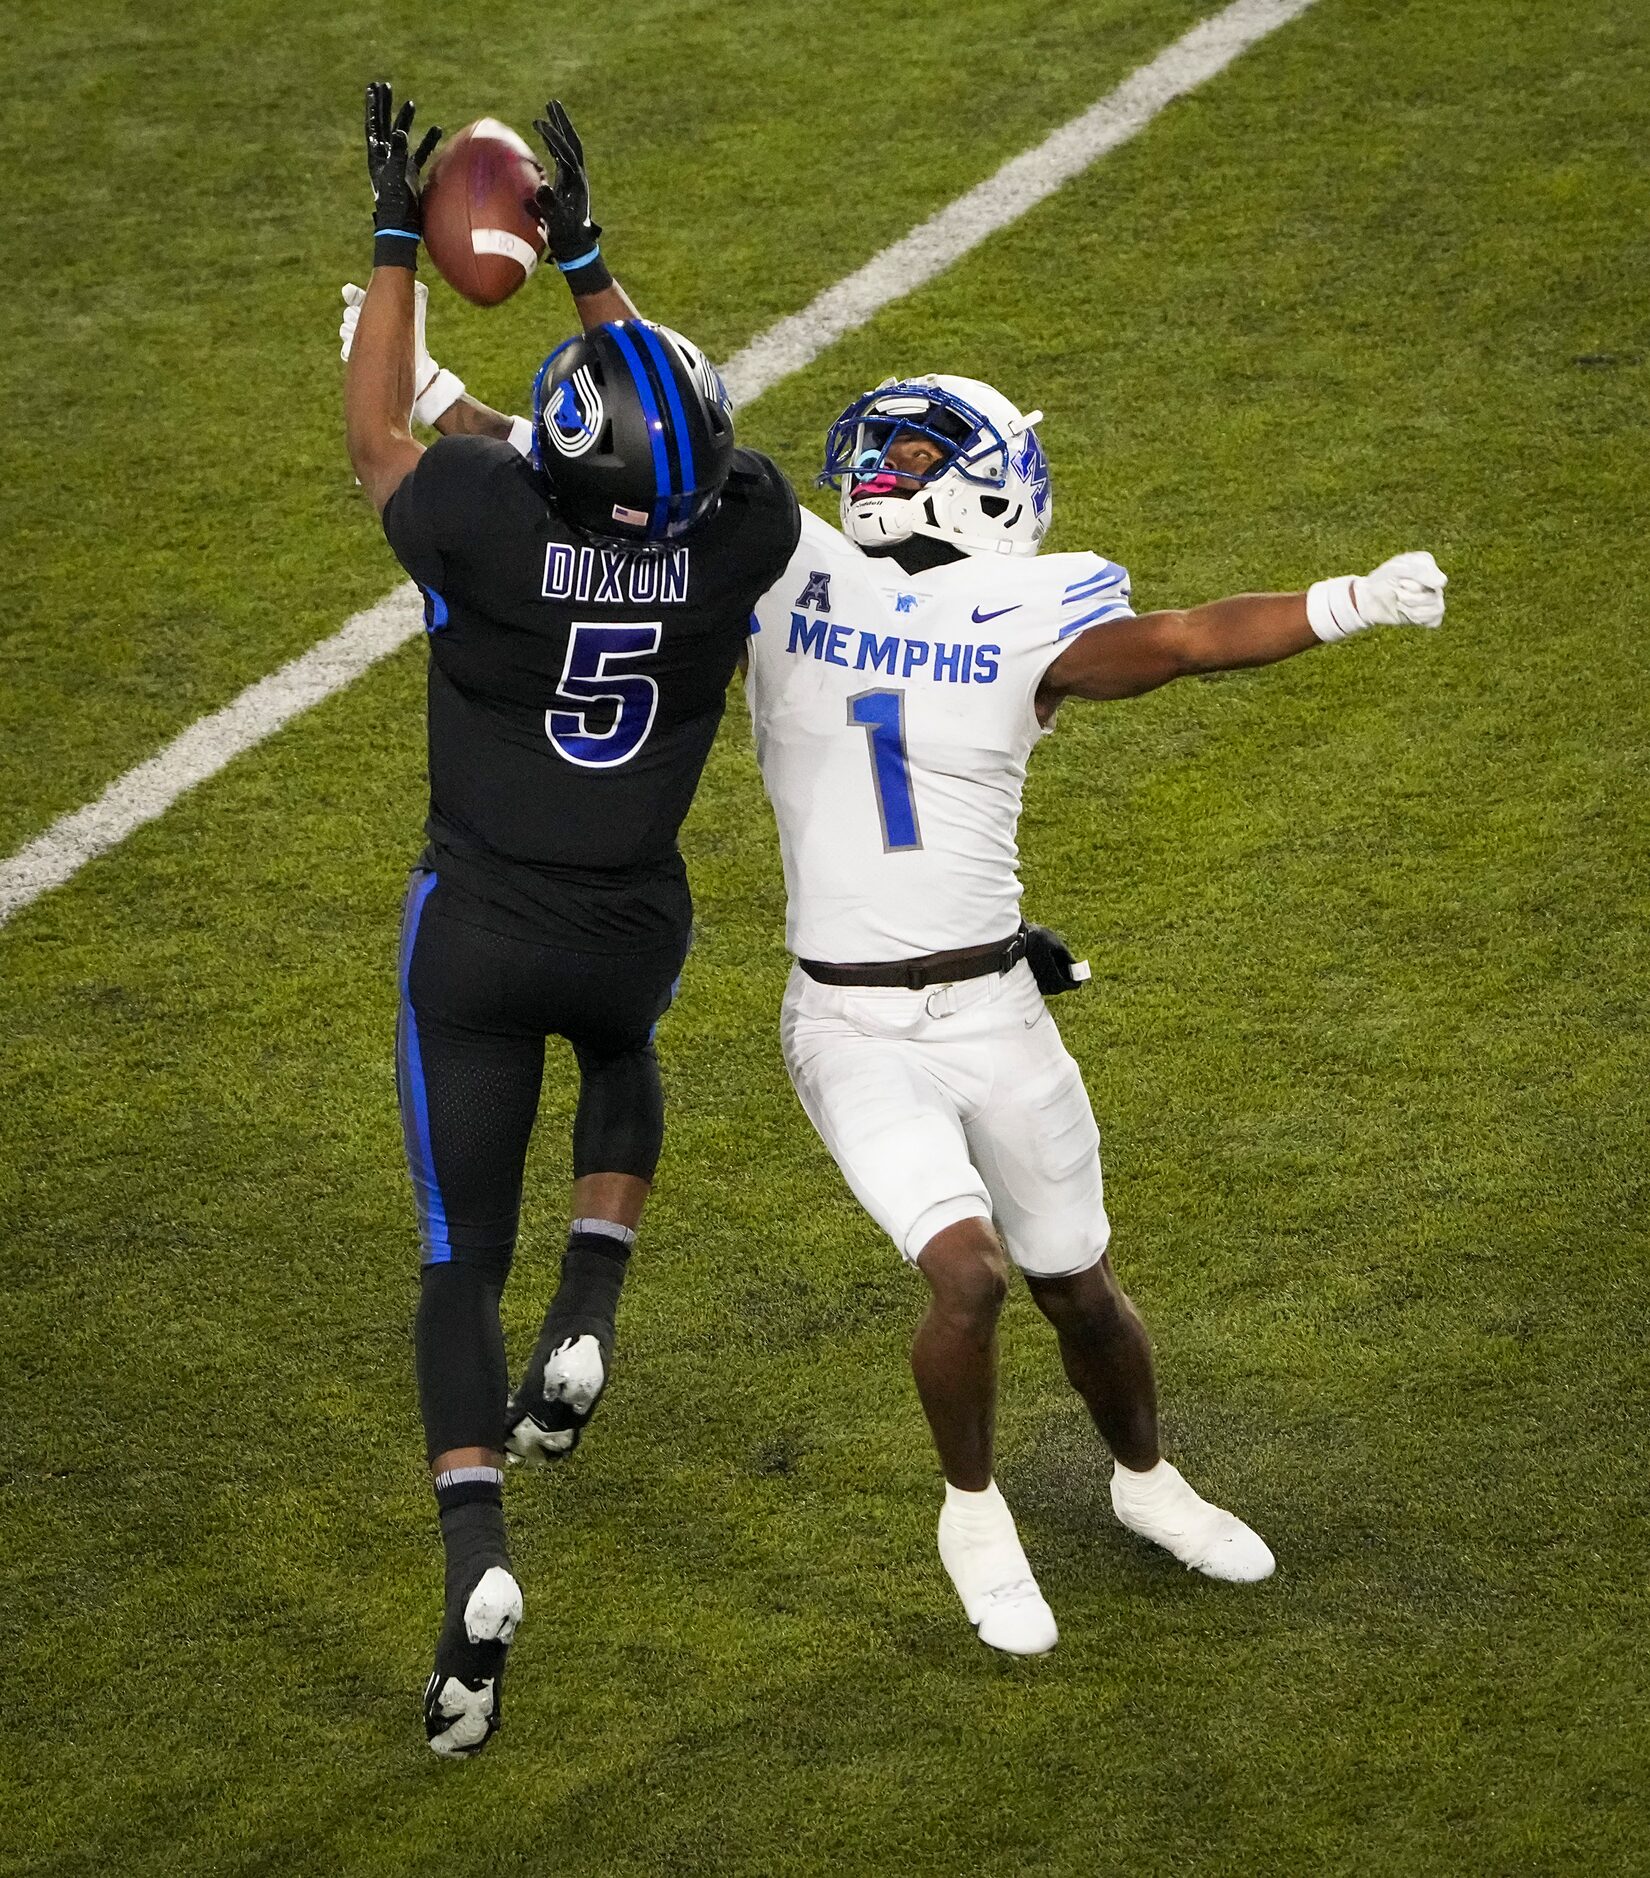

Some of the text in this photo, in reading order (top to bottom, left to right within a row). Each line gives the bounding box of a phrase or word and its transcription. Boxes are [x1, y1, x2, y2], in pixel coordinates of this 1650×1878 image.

[541, 542, 689, 603] DIXON
[545, 621, 662, 768] 5
[785, 611, 1001, 684] MEMPHIS
[846, 686, 924, 854] 1
